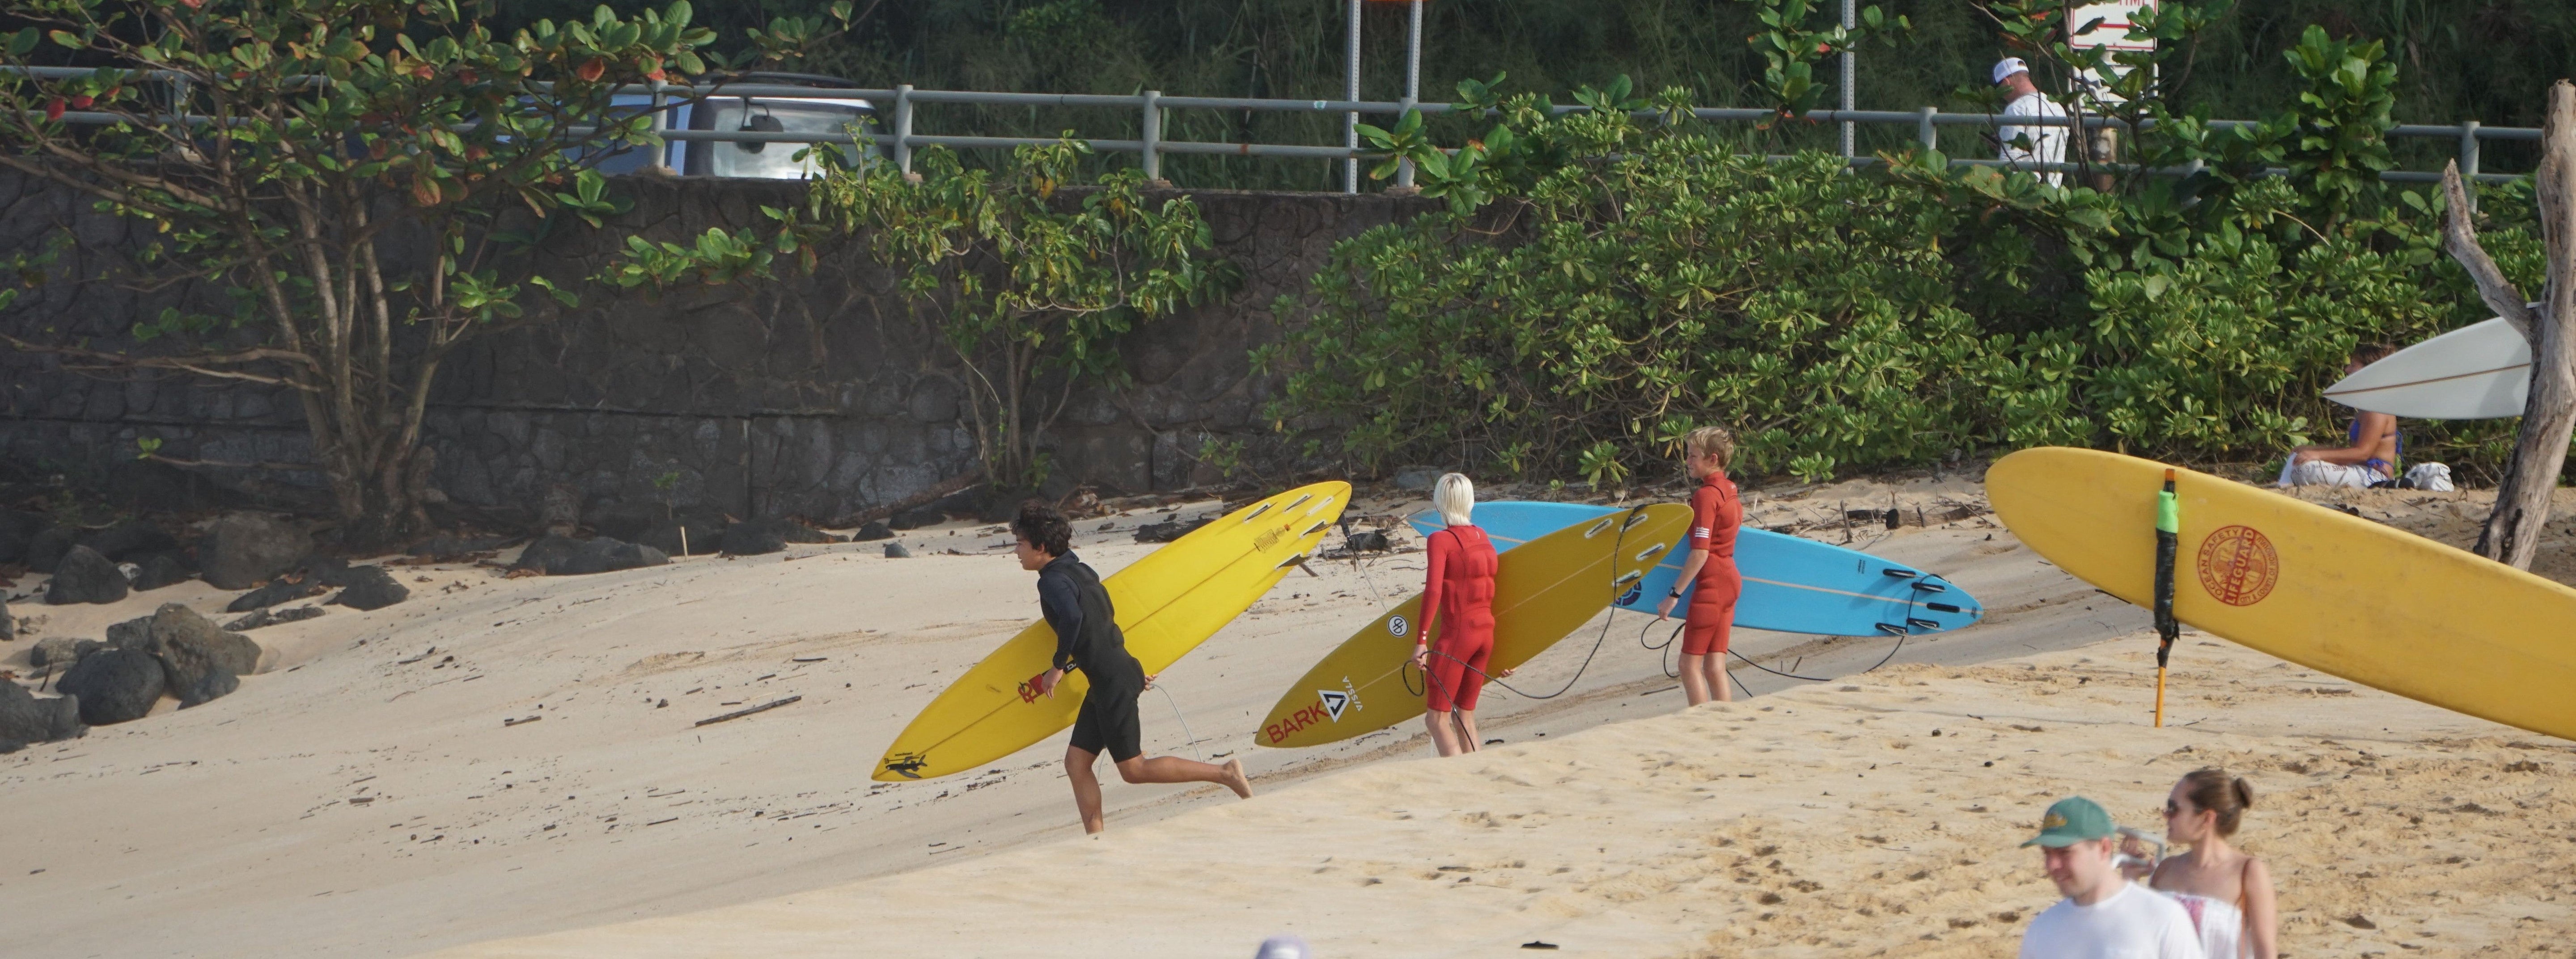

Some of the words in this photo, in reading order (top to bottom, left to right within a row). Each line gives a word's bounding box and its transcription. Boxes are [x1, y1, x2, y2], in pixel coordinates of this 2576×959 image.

[2203, 529, 2239, 556] SAFETY
[2201, 560, 2222, 596] OCEAN
[2225, 529, 2254, 604] LIFEGUARD
[1342, 675, 1363, 712] VISSLA
[1266, 700, 1330, 744] BARK
